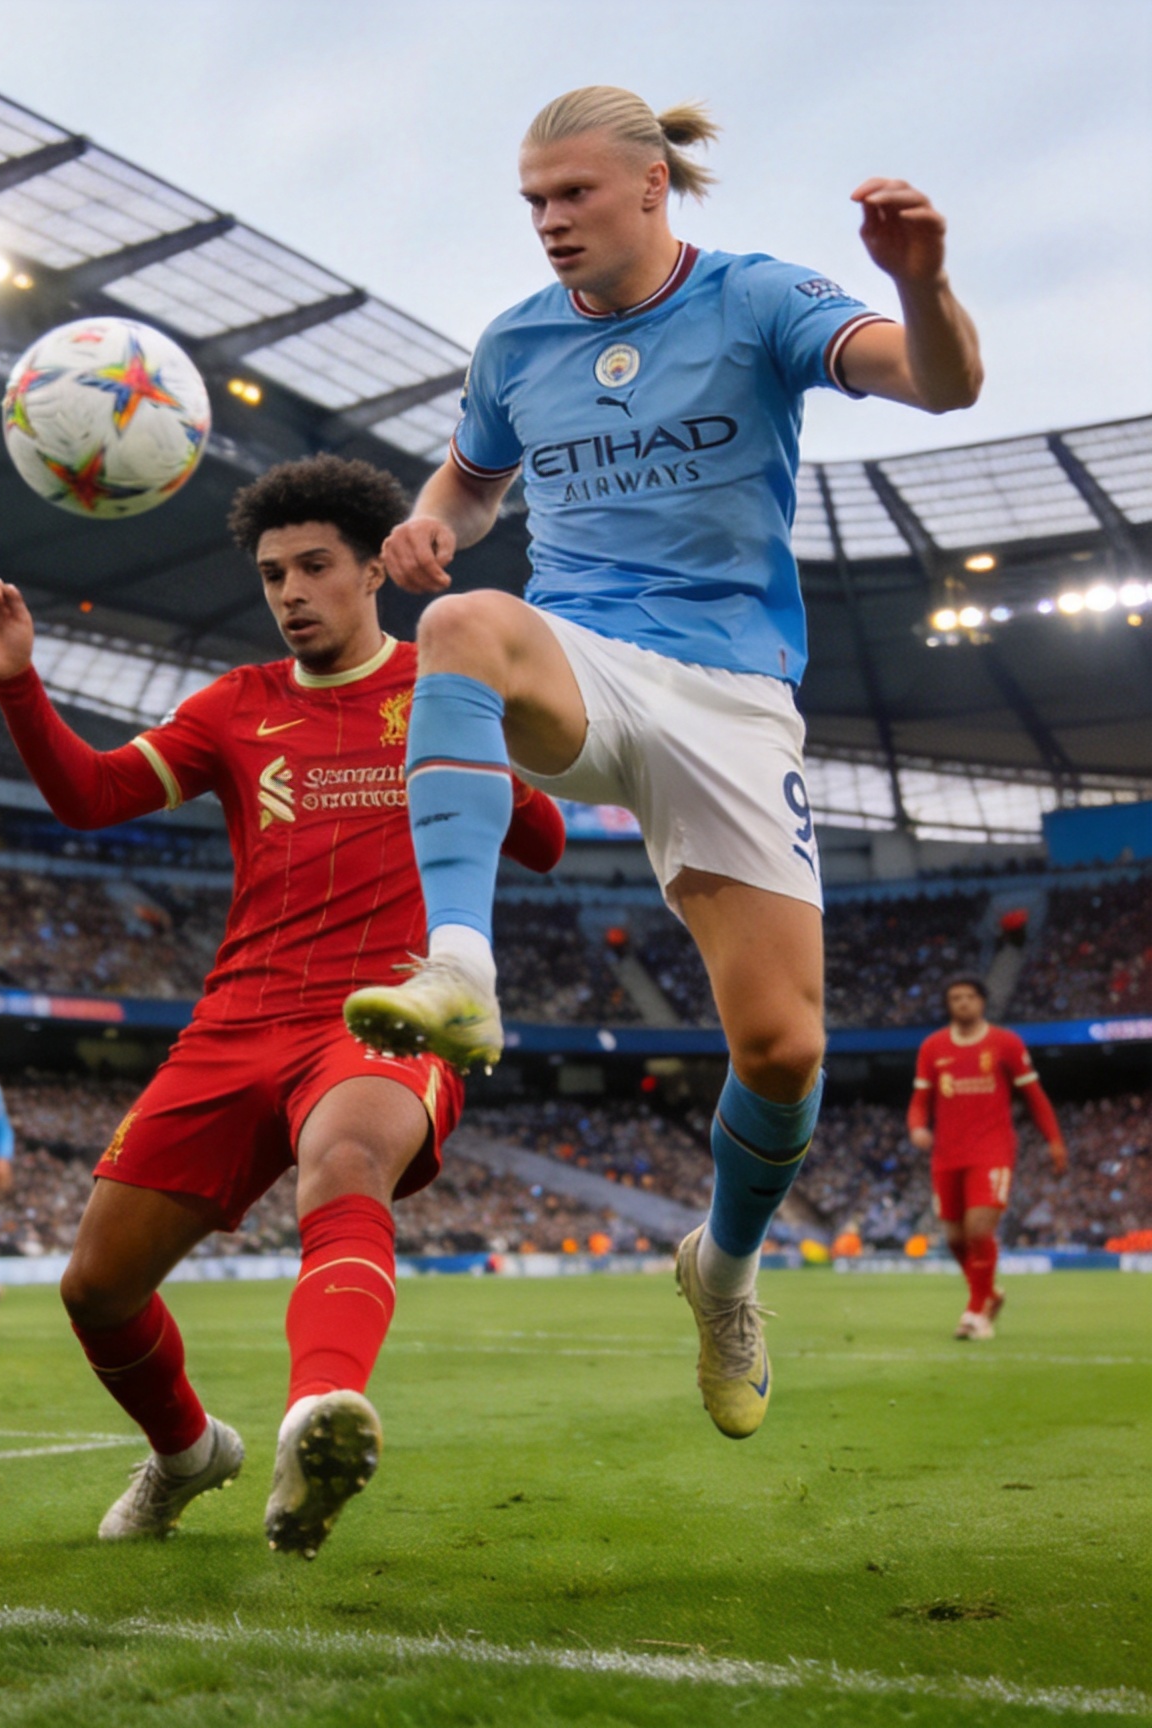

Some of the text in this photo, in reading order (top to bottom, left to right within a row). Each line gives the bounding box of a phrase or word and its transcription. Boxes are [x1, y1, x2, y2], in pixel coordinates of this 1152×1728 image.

[531, 415, 739, 479] ETIHAD
[562, 459, 701, 505] AIRWAYS
[782, 770, 813, 843] 9
